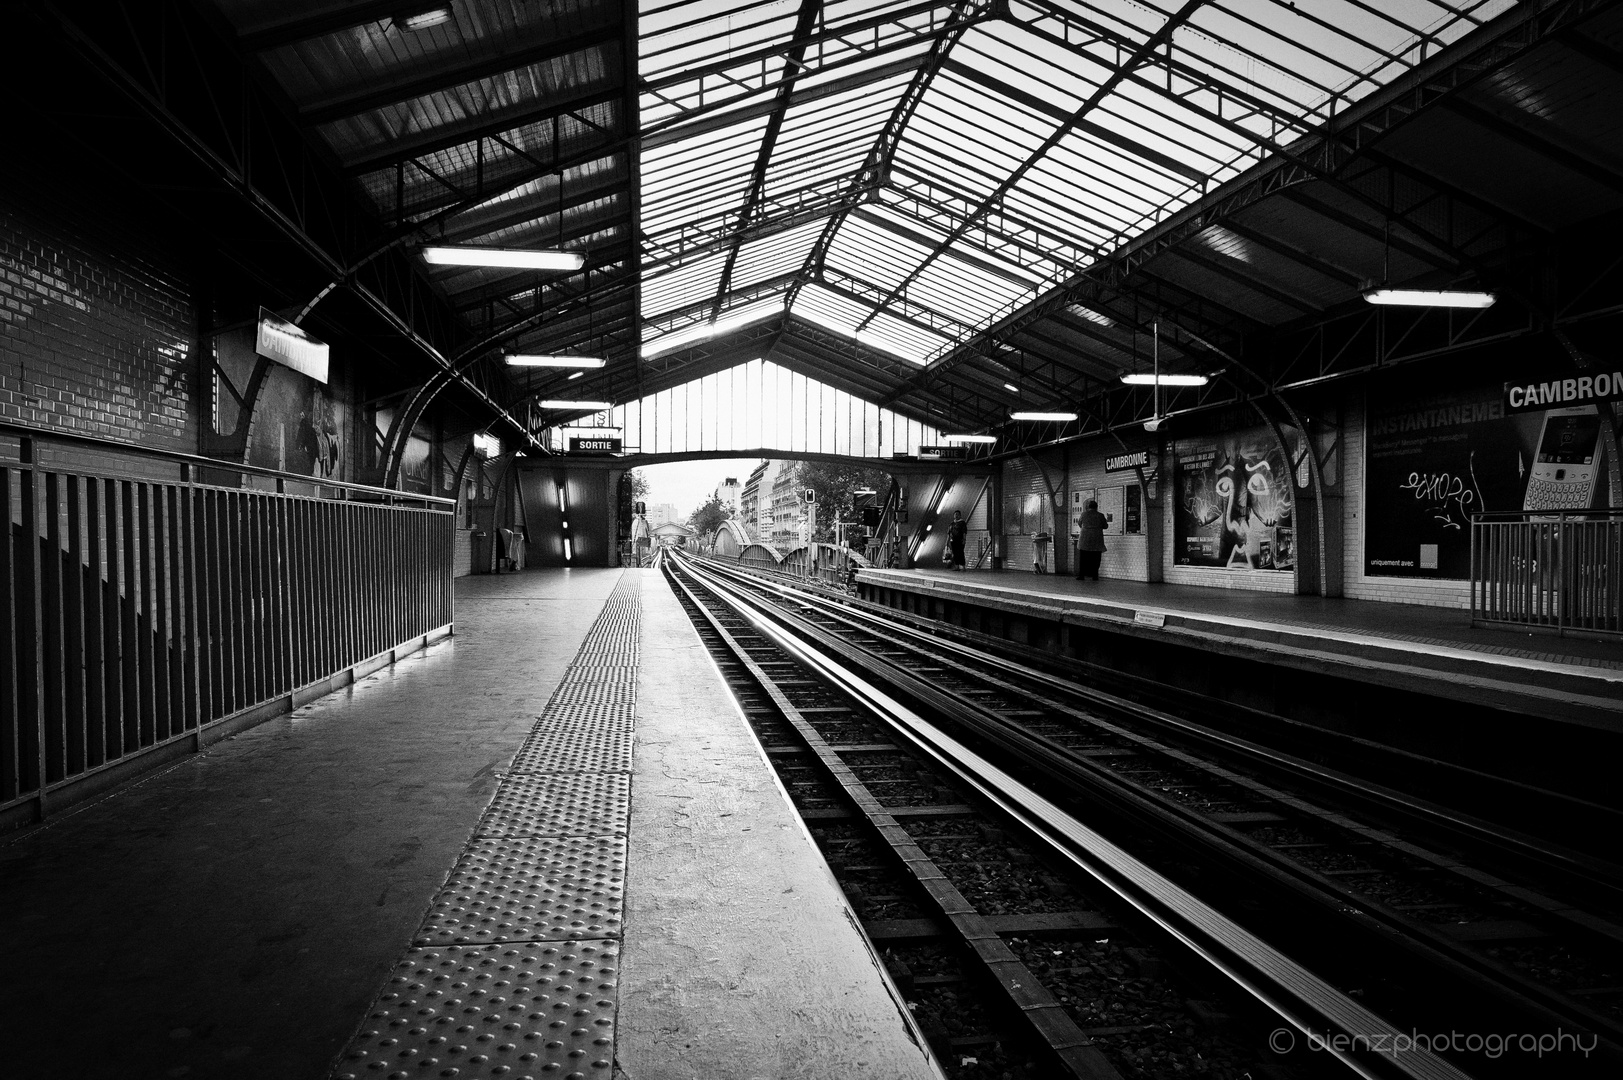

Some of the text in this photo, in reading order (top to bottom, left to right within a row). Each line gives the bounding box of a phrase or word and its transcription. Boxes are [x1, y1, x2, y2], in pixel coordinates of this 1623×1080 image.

[579, 441, 612, 450] SORTIE
[930, 449, 959, 457] SORTIE
[1106, 451, 1148, 470] CAMBRONNE
[1371, 559, 1400, 567] uniquement
